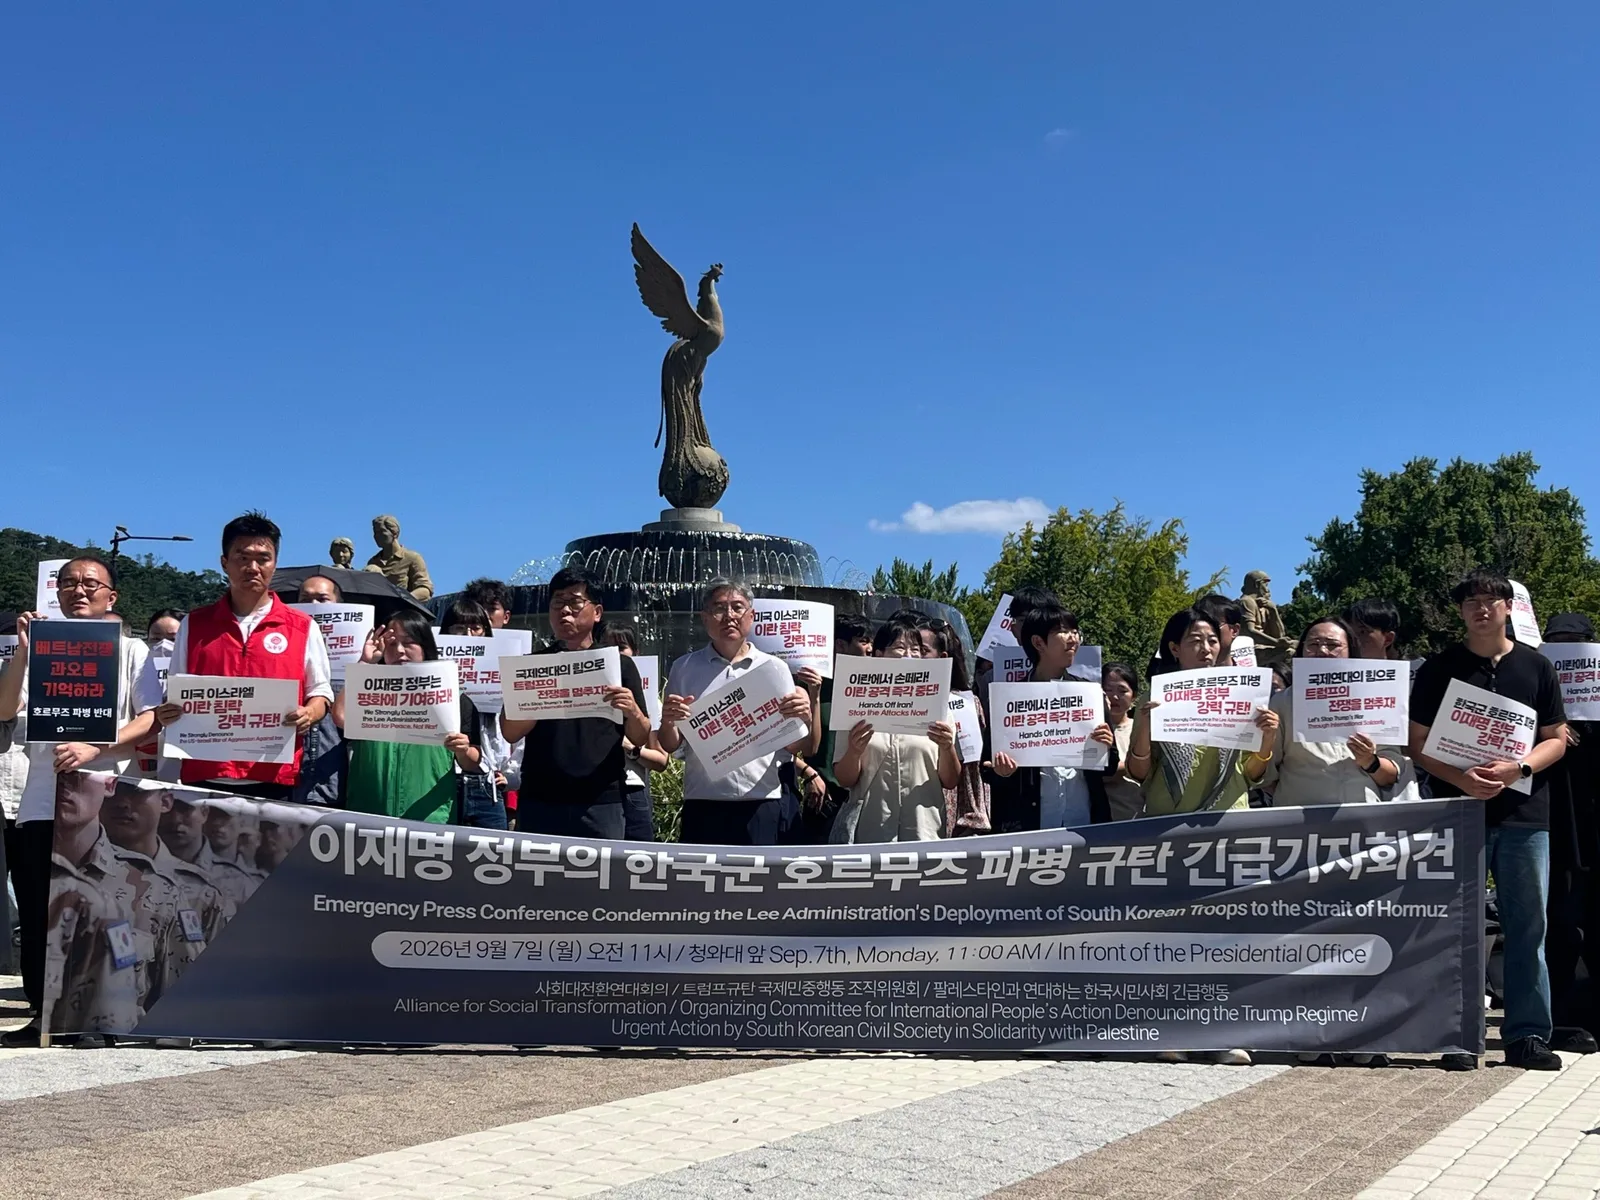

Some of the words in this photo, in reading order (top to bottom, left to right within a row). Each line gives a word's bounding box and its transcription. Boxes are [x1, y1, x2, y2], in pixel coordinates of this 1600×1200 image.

[344, 612, 363, 622] 파병
[755, 623, 778, 636] 이란
[780, 622, 801, 635] 침략
[35, 641, 113, 656] 베트남전쟁
[784, 635, 805, 648] 강력
[446, 646, 485, 656] 이스라엘
[51, 662, 97, 677] 과오를
[516, 664, 571, 679] 국제연대의
[572, 658, 605, 674] 힘으로
[1555, 658, 1596, 671] 이란에서
[364, 678, 402, 691] 이재명
[405, 675, 441, 690] 정부는
[849, 673, 893, 684] 이란에서
[895, 672, 929, 684] 손떼라!
[1163, 680, 1194, 692] 한국군
[1196, 676, 1238, 687] 호르무즈
[1240, 675, 1261, 687] 파병
[1308, 670, 1363, 685] 국제연대의
[1365, 669, 1396, 682] 힘으로
[1574, 671, 1595, 682] 공격
[42, 683, 105, 698] 기억하라
[513, 679, 557, 690] 트럼프의
[845, 687, 867, 697] 이란
[869, 686, 890, 697] 공격
[892, 686, 914, 696] 즉각
[915, 684, 940, 696] 중단!
[181, 689, 204, 699] 미국
[207, 687, 254, 699] 이스라엘
[358, 692, 397, 706] 평화에
[537, 688, 569, 699] 전쟁을
[1164, 689, 1202, 702] 이재명
[1204, 687, 1230, 700] 정부
[1305, 686, 1349, 700] 트럼프의
[183, 700, 211, 714] 이란
[214, 700, 242, 714] 침략
[689, 710, 710, 729] 미국
[709, 687, 746, 716] 이스라엘
[1007, 698, 1049, 713] 이란에서
[1050, 696, 1083, 710] 손떼라!
[1197, 702, 1222, 714] 강력
[1224, 702, 1251, 715] 규탄!
[1329, 698, 1361, 712] 전쟁을
[1364, 697, 1396, 710] 멈추자!
[1453, 697, 1487, 716] 한국군
[33, 707, 70, 717] 호르무즈
[72, 707, 91, 718] 파병
[94, 708, 112, 718] 반대
[1004, 715, 1025, 727] 이란
[1027, 713, 1047, 726] 공격
[1049, 711, 1070, 723] 즉각
[1071, 708, 1094, 721] 중단!
[218, 715, 246, 730] 강력
[249, 713, 281, 727] 규탄!
[698, 719, 722, 740] 이란
[721, 704, 745, 727] 침략
[731, 713, 756, 736] 강력
[1450, 709, 1491, 731] 이재명
[1490, 721, 1515, 736] 정부
[1019, 730, 1042, 739] Hands
[1044, 729, 1055, 738] Off
[1056, 728, 1071, 737] Iran!
[1477, 732, 1504, 749] 강력
[310, 823, 455, 881] 이재명
[465, 834, 612, 890] 정부의
[624, 850, 770, 892] 한국군
[778, 851, 968, 891] 호르무즈
[976, 844, 1073, 886] 파병
[1079, 842, 1174, 886] 규탄
[1182, 828, 1455, 886] 긴급기자회견
[314, 895, 419, 920] Emergency
[423, 901, 476, 919] Press
[480, 903, 589, 922] Conference
[592, 908, 710, 924] Condemning
[715, 909, 743, 921] the
[747, 908, 779, 921] Lee
[782, 904, 930, 922] Administration's
[934, 904, 1042, 925] Deployment
[1046, 905, 1065, 921] of
[1068, 906, 1121, 921] South
[1125, 905, 1186, 920] Korean
[1190, 903, 1248, 920] Troops
[1251, 901, 1269, 916] to
[1271, 900, 1300, 916] the
[1303, 900, 1353, 917] Strait
[1355, 900, 1374, 917] of
[1377, 901, 1448, 917] Hormuz
[400, 940, 471, 959] 2026년
[476, 940, 507, 960] 9월
[512, 941, 543, 960] 7일
[549, 940, 582, 962] (월)
[586, 941, 623, 963] 오전
[630, 943, 672, 962] 11시
[689, 943, 743, 963] 청와대
[747, 944, 764, 964] 앞
[948, 945, 1004, 960] 11:00
[1007, 943, 1041, 960] AM
[1058, 941, 1075, 961] In
[1080, 943, 1125, 961] front
[1131, 942, 1152, 962] of
[1155, 944, 1185, 962] the
[1190, 943, 1302, 963] Presidential
[1306, 944, 1367, 963] Office
[535, 980, 669, 998] 사회대전환연대회의
[682, 983, 756, 997] 트럼프규탄
[758, 980, 845, 997] 국제민중행동
[848, 981, 920, 999] 조직위원회
[933, 981, 1020, 999] 팔레스타인과
[1023, 982, 1081, 999] 연대하는
[1084, 984, 1169, 1000] 한국시민사회
[1172, 983, 1229, 1002] 긴급행동
[394, 999, 460, 1013] Alliance
[463, 999, 485, 1012] for
[489, 999, 539, 1013] Social
[541, 999, 667, 1015] Transformation
[680, 1000, 766, 1020] Organizing
[769, 1000, 862, 1017] Committee
[864, 1001, 887, 1017] for
[890, 1002, 988, 1019] International
[1060, 1003, 1112, 1020] Action
[1114, 1004, 1210, 1024] Denouncing
[1214, 1005, 1238, 1020] the
[1241, 1005, 1292, 1025] Trump
[1296, 1006, 1358, 1025] Regime
[612, 1019, 665, 1039] Urgent
[668, 1020, 721, 1036] Action
[724, 1020, 743, 1040] by
[746, 1021, 793, 1037] South
[797, 1021, 854, 1038] Korean
[857, 1022, 890, 1038] Civil
[893, 1022, 952, 1042] Society
[955, 1023, 969, 1039] in
[972, 1023, 1045, 1043] Solidarity
[1049, 1024, 1083, 1039] with
[1086, 1024, 1160, 1041] Palestine
